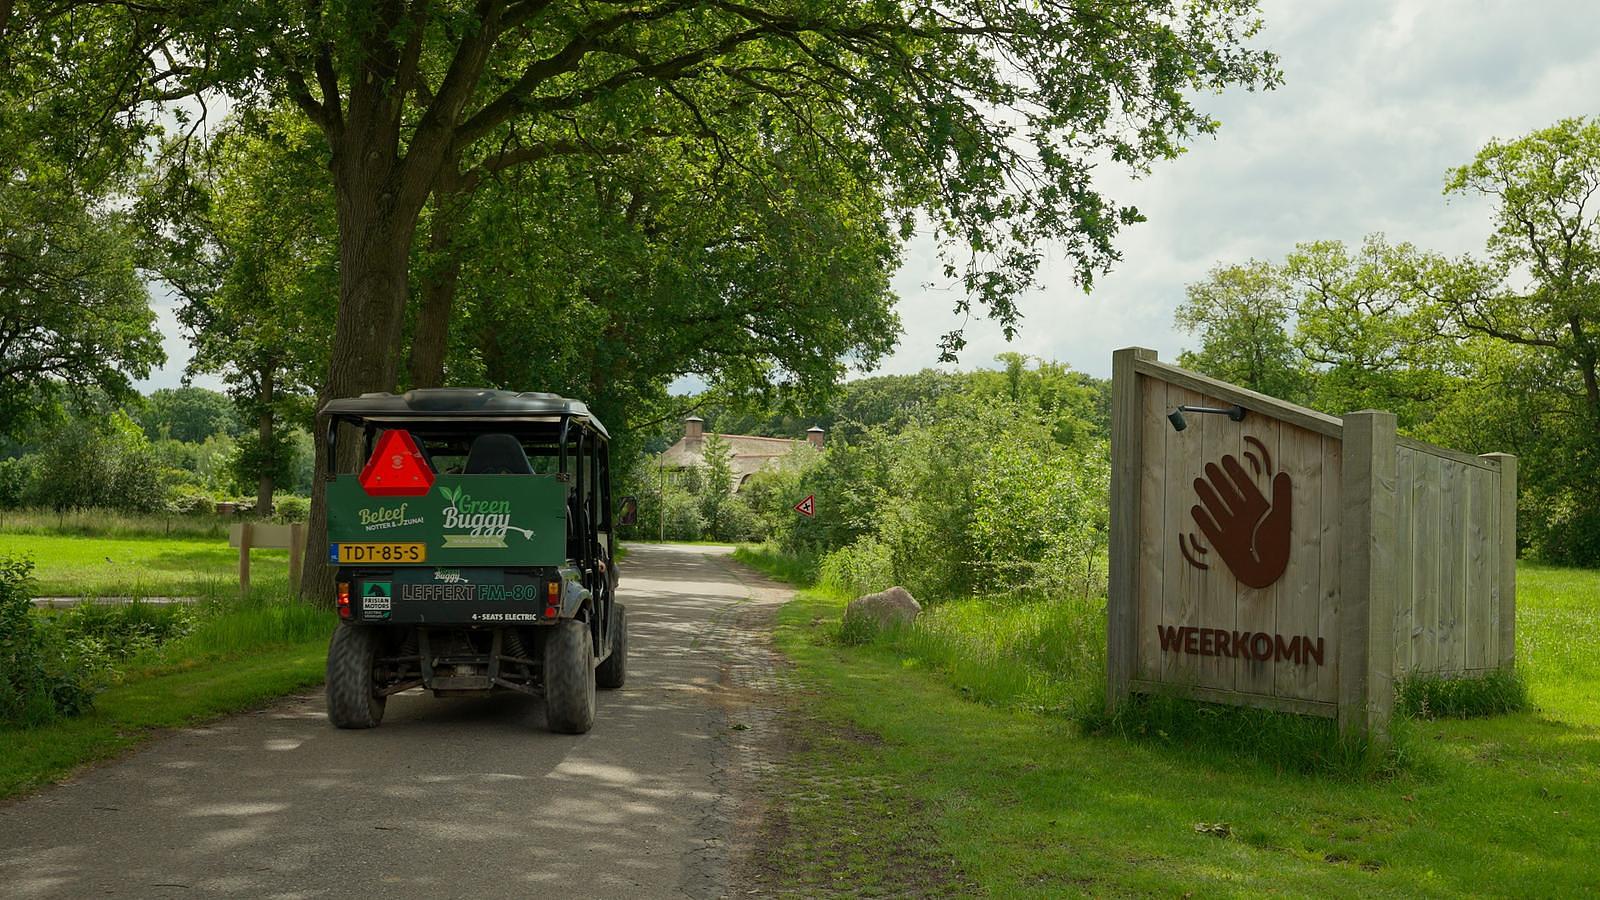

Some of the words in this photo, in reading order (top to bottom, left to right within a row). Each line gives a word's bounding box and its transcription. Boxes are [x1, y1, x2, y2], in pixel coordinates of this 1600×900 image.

[460, 494, 511, 514] Green
[359, 503, 408, 527] Beleef
[442, 506, 511, 538] Buggy
[366, 521, 391, 531] NOTTER
[344, 546, 419, 560] TDT-85-S
[433, 571, 461, 583] Buggy
[402, 584, 476, 600] LEFFERT
[478, 584, 537, 600] FM-80
[1157, 625, 1324, 666] WEERKOMN
